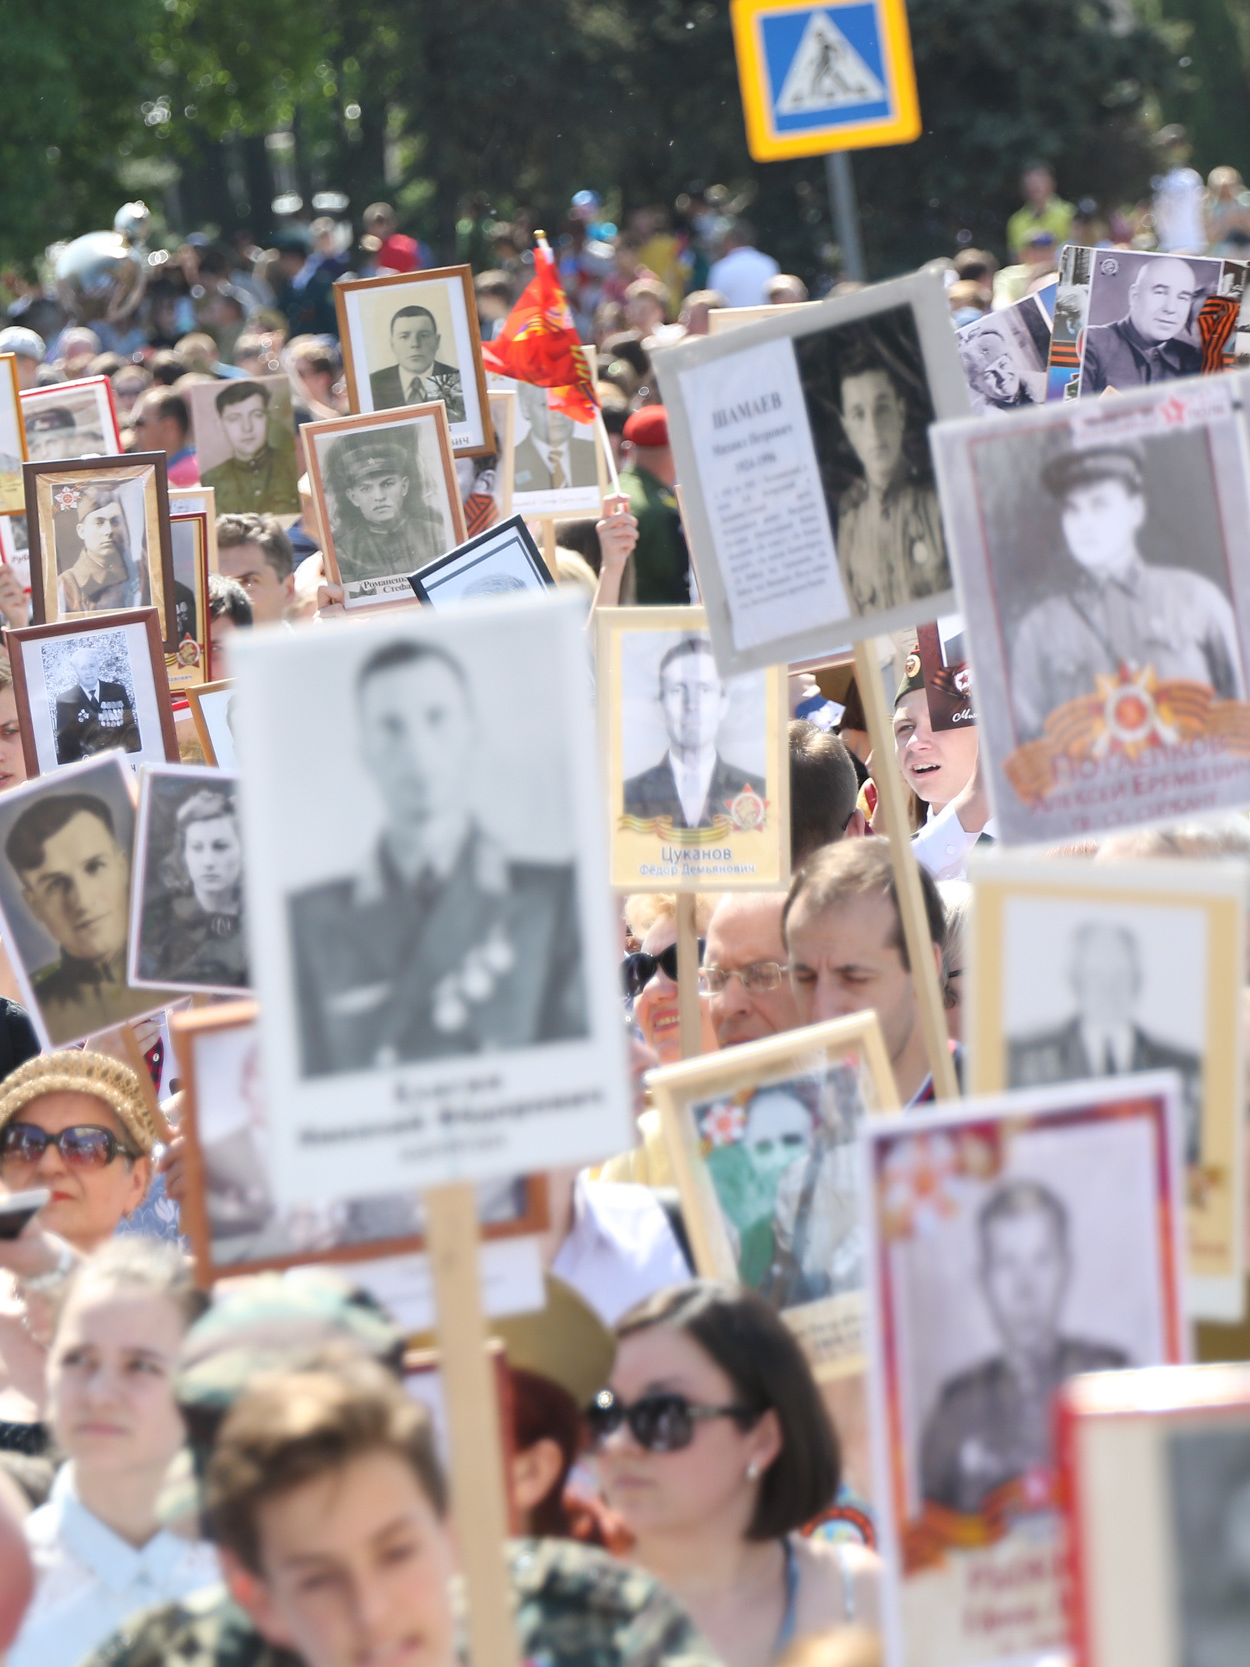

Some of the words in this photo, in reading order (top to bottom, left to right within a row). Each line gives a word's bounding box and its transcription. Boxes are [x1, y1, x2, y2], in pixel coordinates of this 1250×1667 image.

[711, 392, 782, 430] ШАМАЕВ
[661, 846, 732, 864] Цуканов
[681, 863, 755, 876] Демьянович
